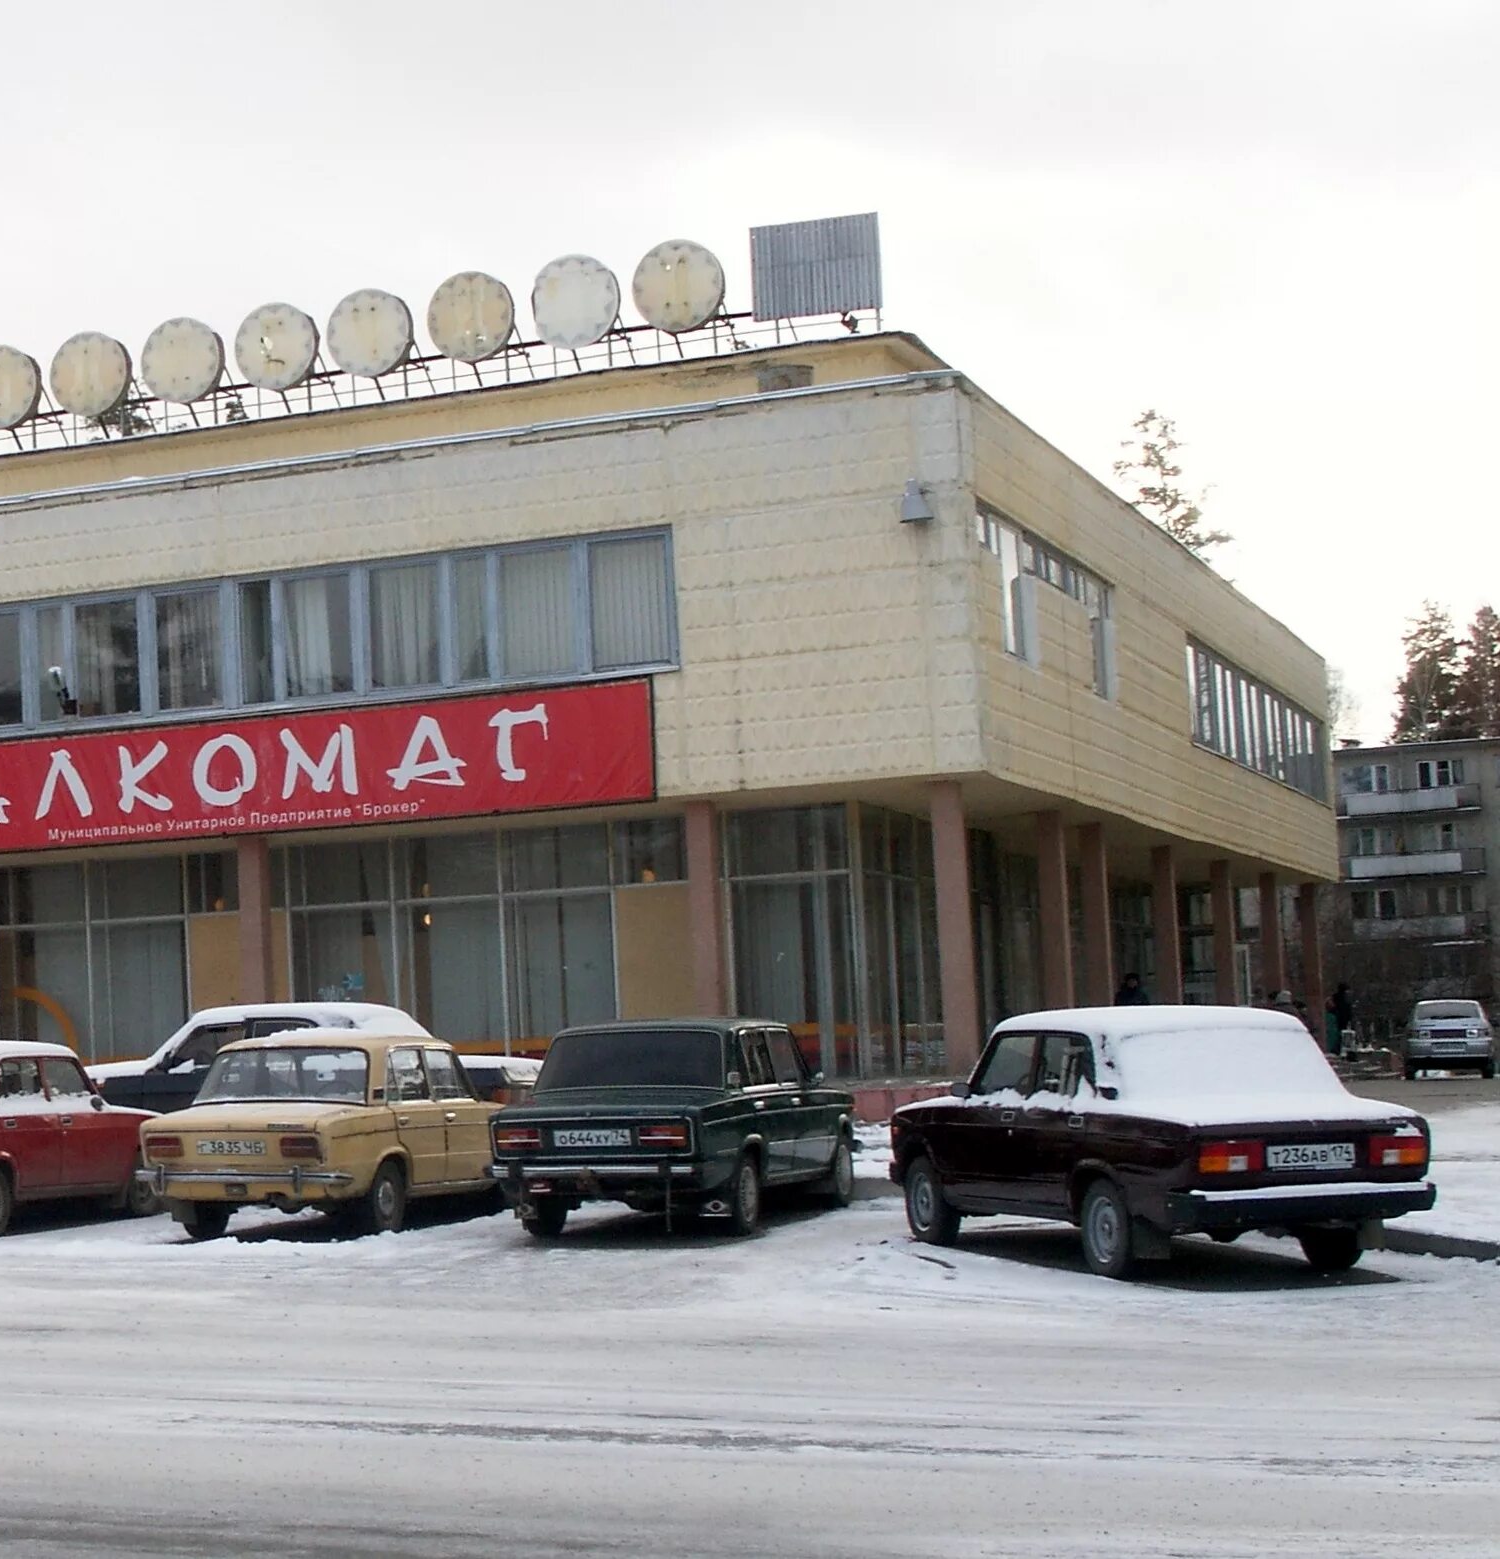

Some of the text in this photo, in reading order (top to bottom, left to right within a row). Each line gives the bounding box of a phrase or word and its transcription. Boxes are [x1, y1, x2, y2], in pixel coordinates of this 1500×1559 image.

[48, 799, 426, 842] Муниципальное Унитарное Предприятие "Брокер"
